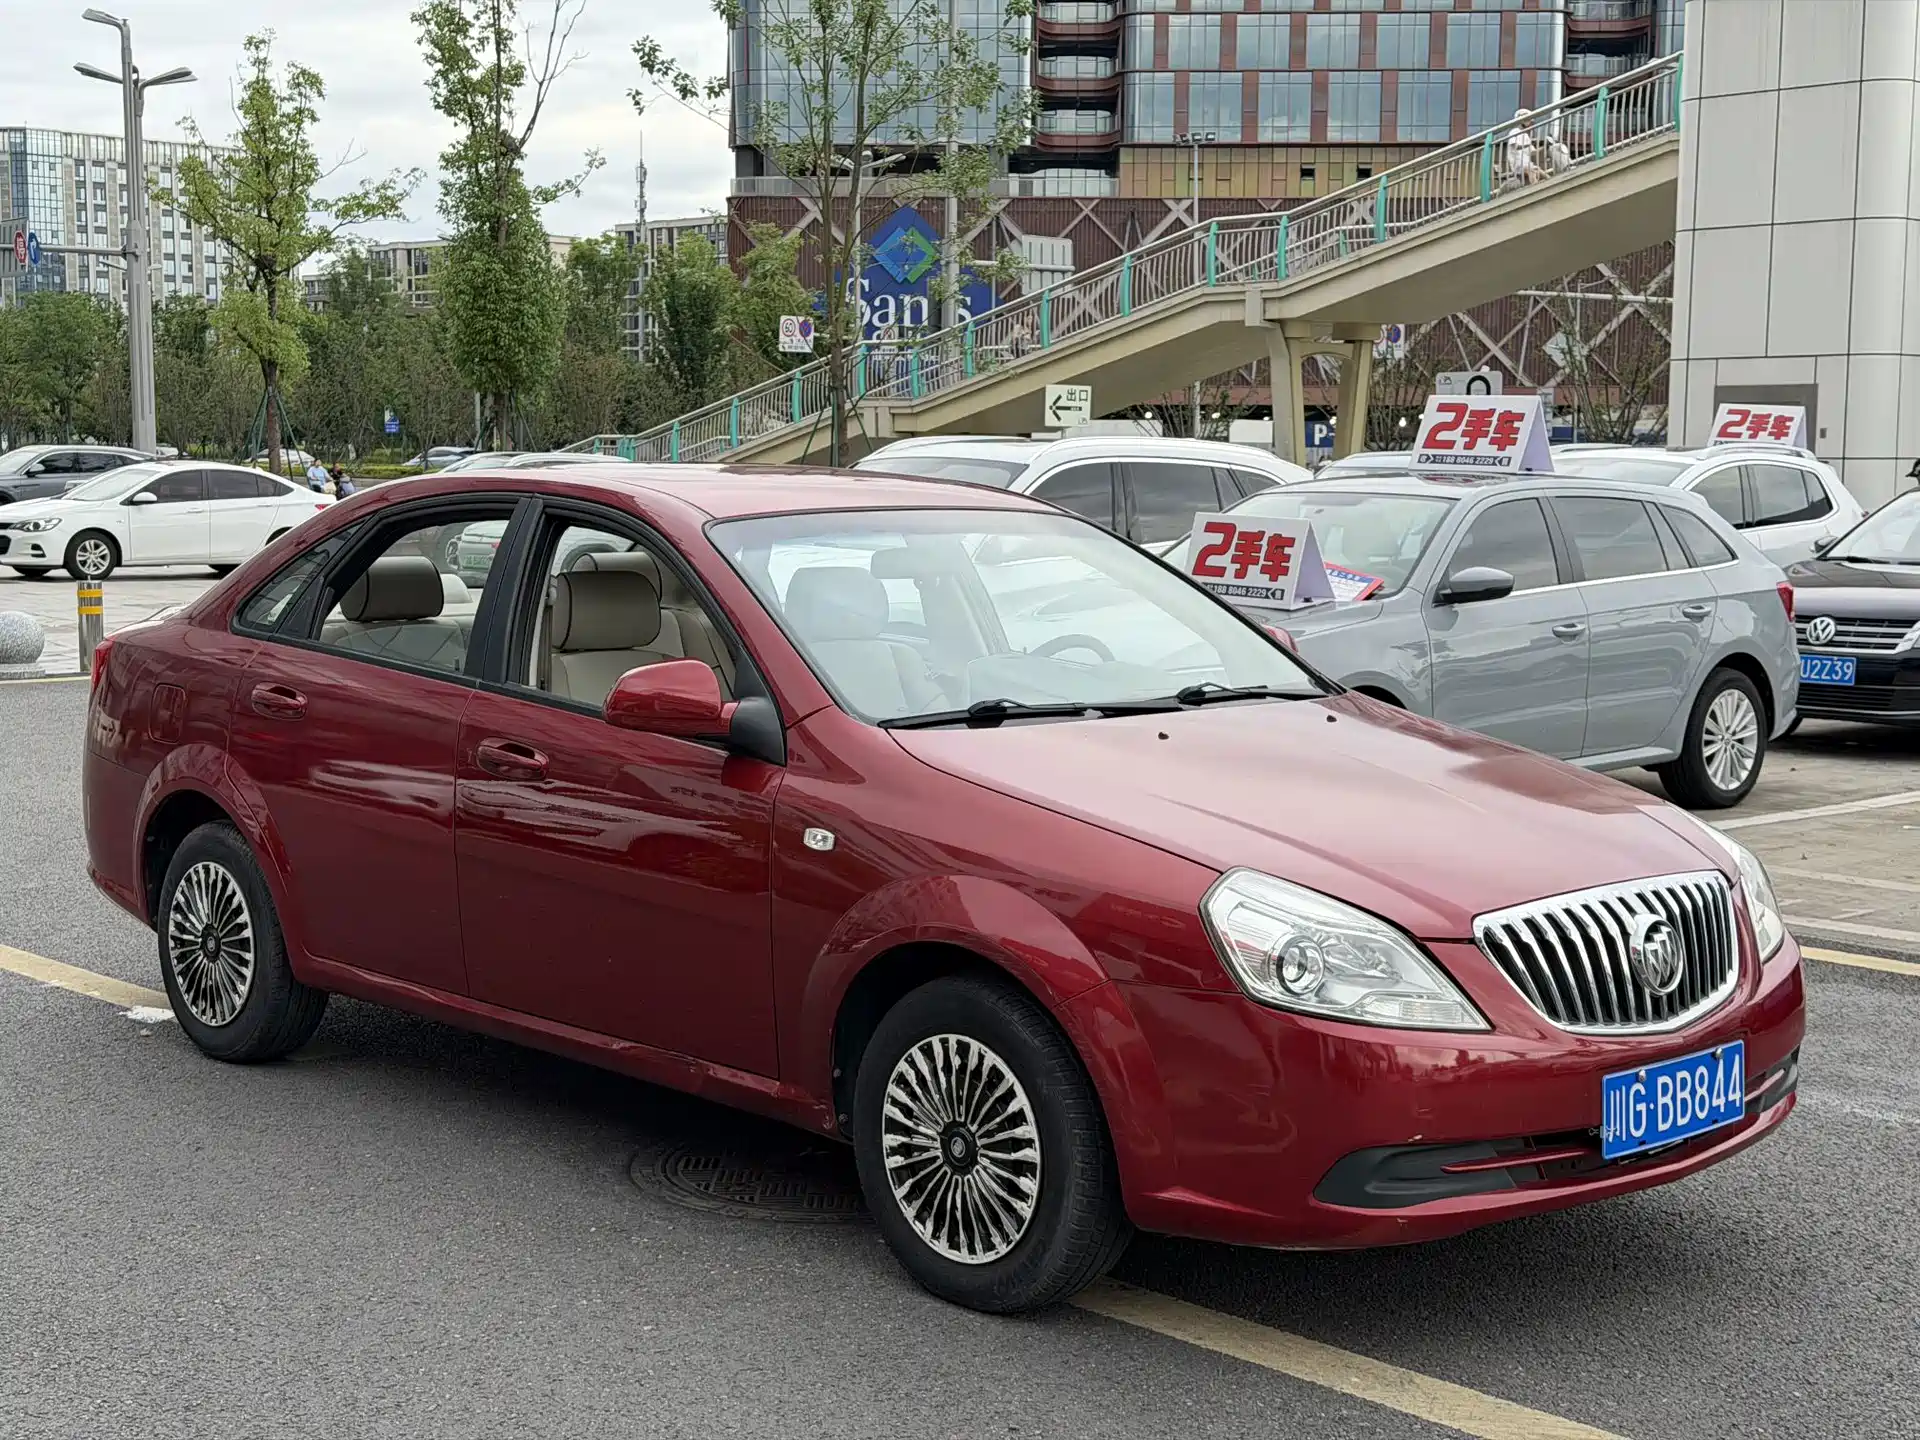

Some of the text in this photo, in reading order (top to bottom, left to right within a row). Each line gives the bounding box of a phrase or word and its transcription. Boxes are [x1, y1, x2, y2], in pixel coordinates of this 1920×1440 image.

[845, 277, 972, 328] Sams
[1066, 387, 1088, 402] 出口
[1313, 423, 1327, 445] P
[1422, 402, 1525, 451] 2手车
[1716, 408, 1794, 440] 2手车
[1191, 521, 1296, 582] 2手车
[1214, 585, 1227, 593] 188
[1227, 586, 1247, 595] 8046
[1247, 587, 1267, 597] 2229
